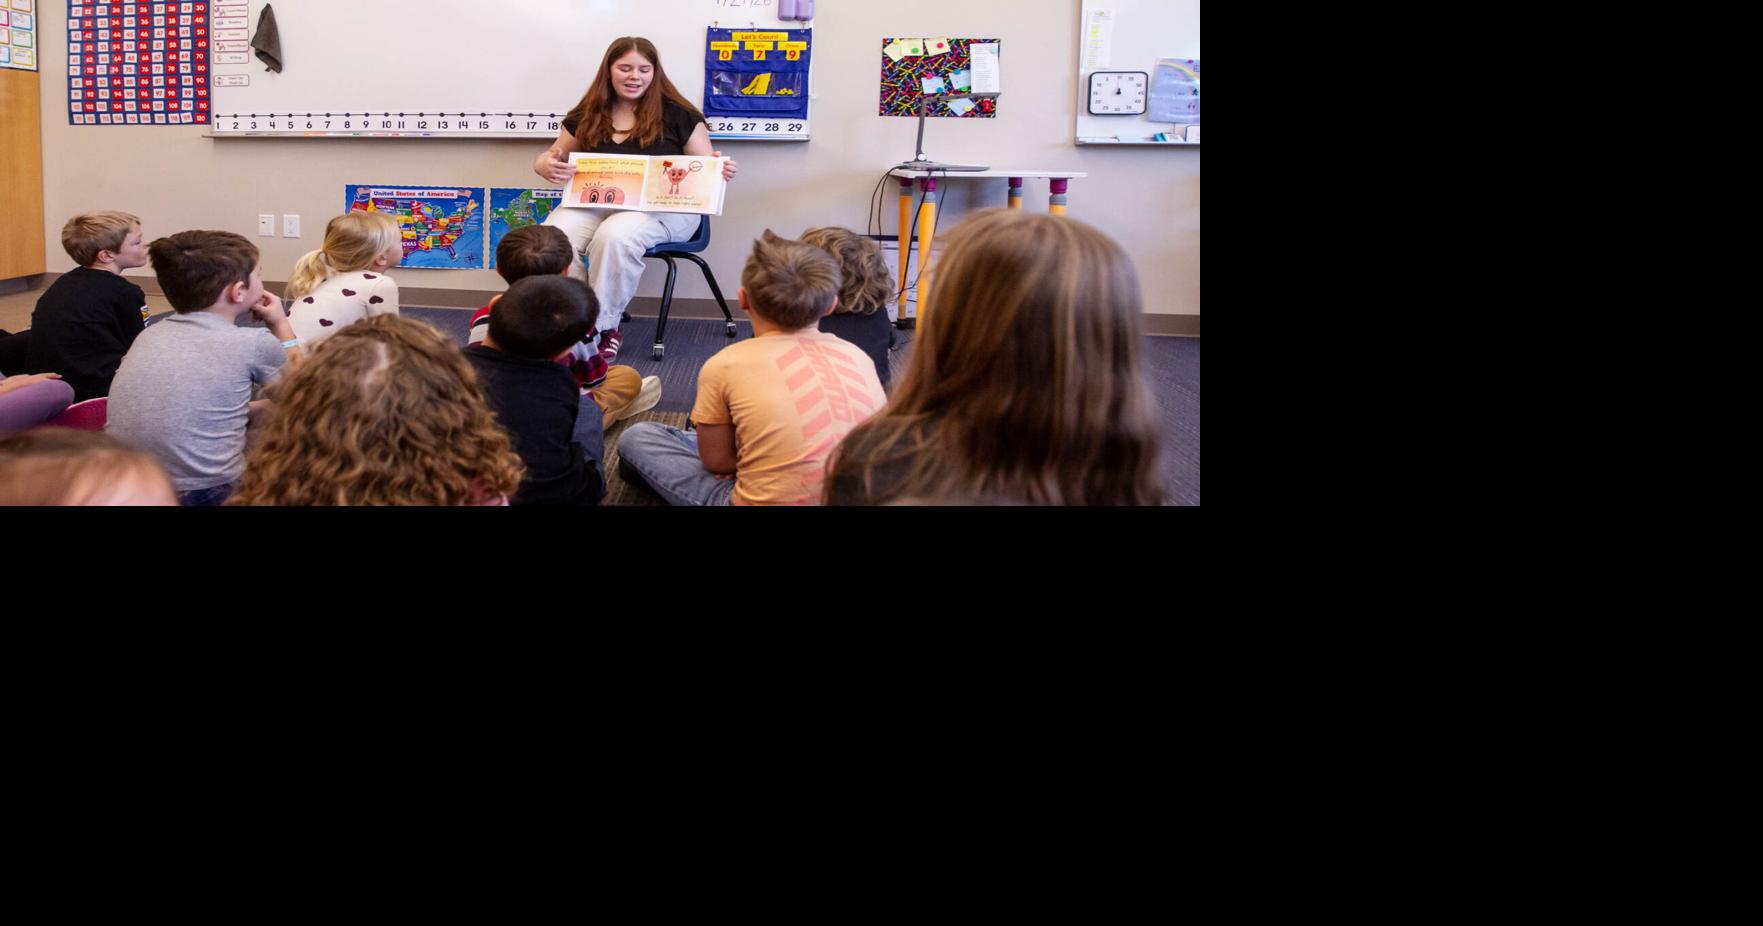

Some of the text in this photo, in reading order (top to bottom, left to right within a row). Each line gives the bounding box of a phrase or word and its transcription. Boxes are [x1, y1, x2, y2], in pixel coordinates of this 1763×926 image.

[721, 50, 796, 59] 0 7 9
[382, 120, 392, 128] 10
[418, 121, 427, 129] 12
[479, 121, 489, 129] 15
[506, 121, 516, 129] 16
[527, 121, 537, 130] 17
[548, 122, 559, 130] 18
[718, 122, 734, 131] 26
[742, 123, 756, 131] 27
[765, 123, 779, 131] 28
[788, 123, 802, 132] 29
